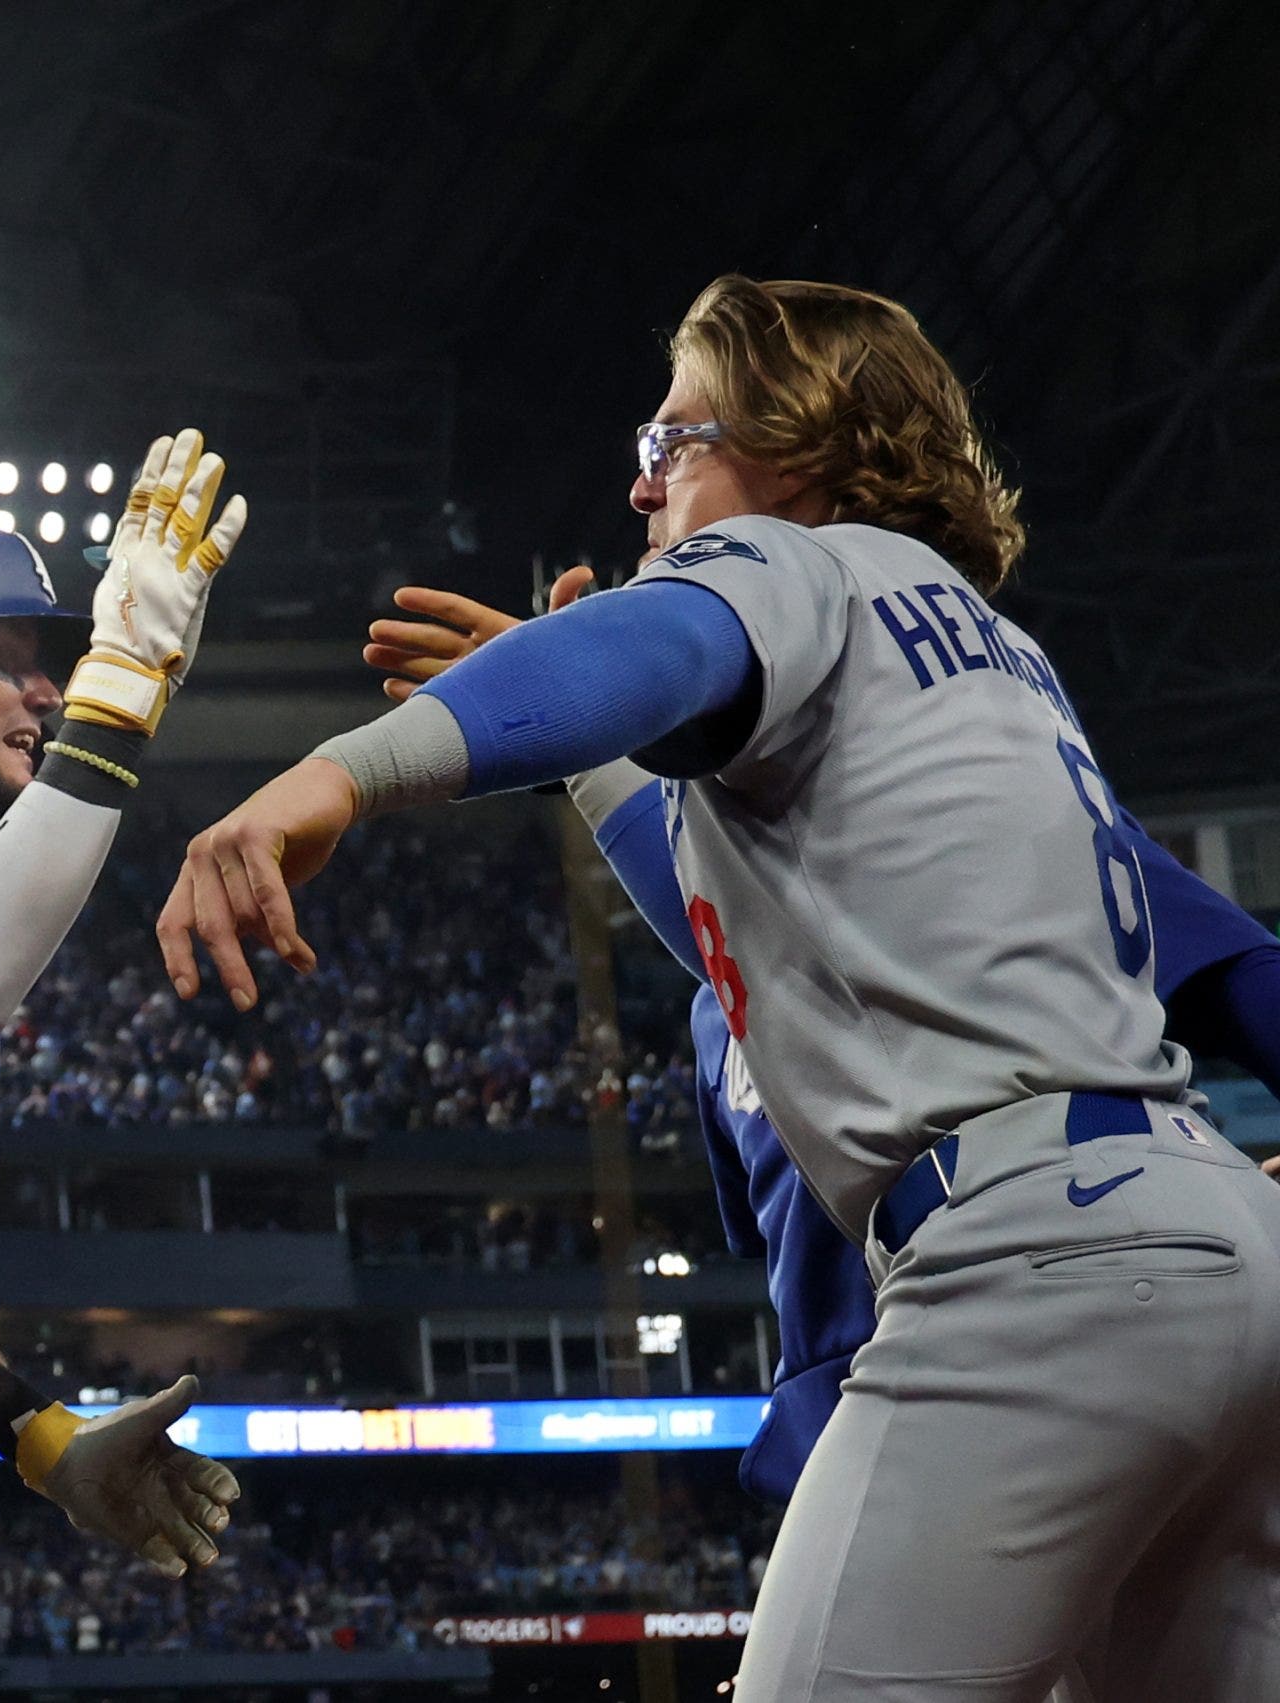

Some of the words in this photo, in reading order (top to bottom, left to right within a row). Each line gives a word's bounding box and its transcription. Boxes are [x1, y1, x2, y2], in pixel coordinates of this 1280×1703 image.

[1056, 728, 1152, 979] 8
[686, 894, 748, 1042] 8
[644, 1612, 726, 1638] PROUD
